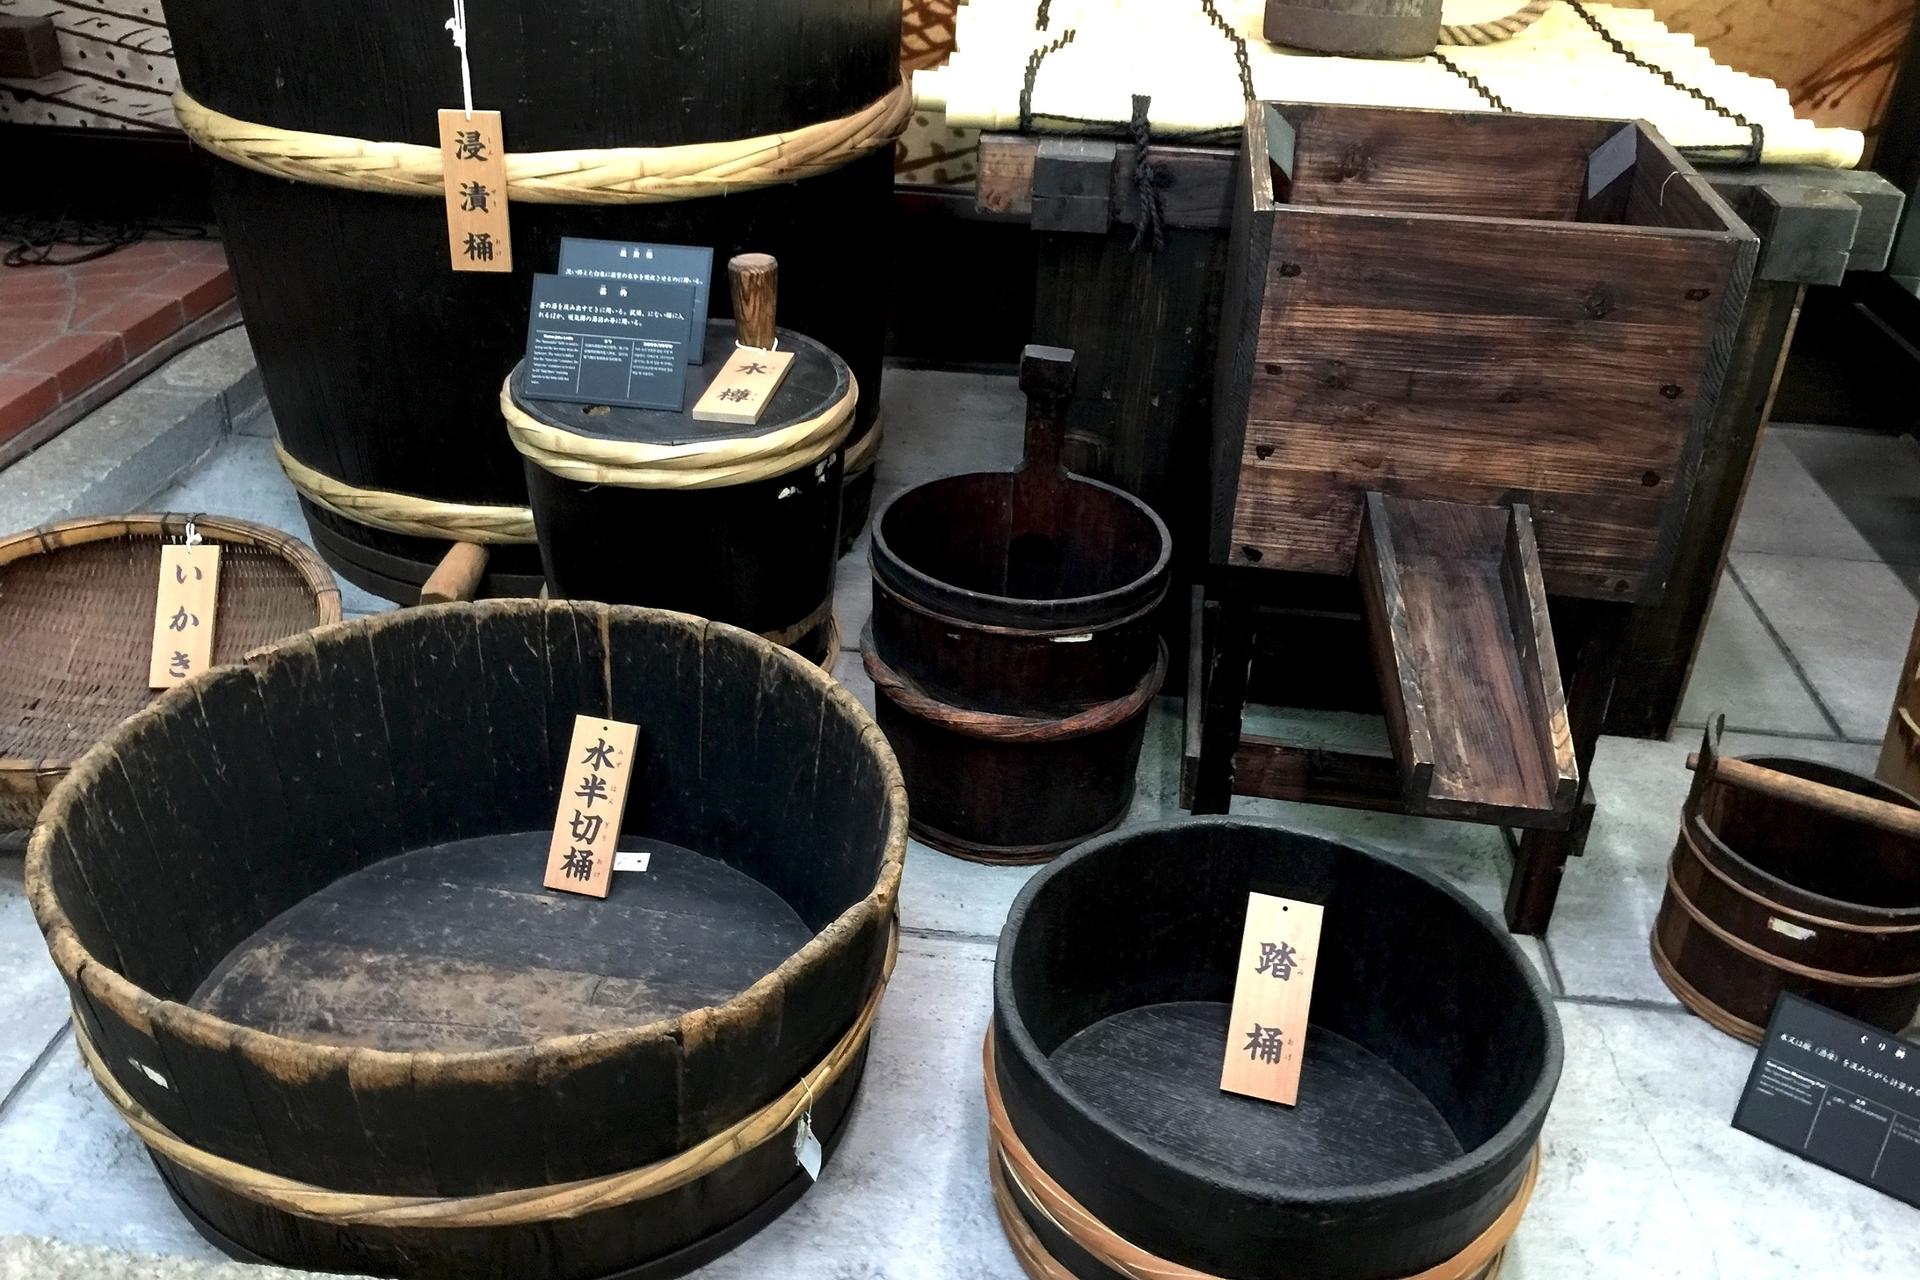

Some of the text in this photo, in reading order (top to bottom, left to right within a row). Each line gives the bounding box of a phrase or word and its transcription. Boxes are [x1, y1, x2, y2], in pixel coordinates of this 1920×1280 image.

[454, 130, 494, 263] 浸漬桶
[168, 564, 203, 679] いかき
[559, 737, 615, 883] 水半切桶
[1242, 940, 1299, 1065] 踏桶
